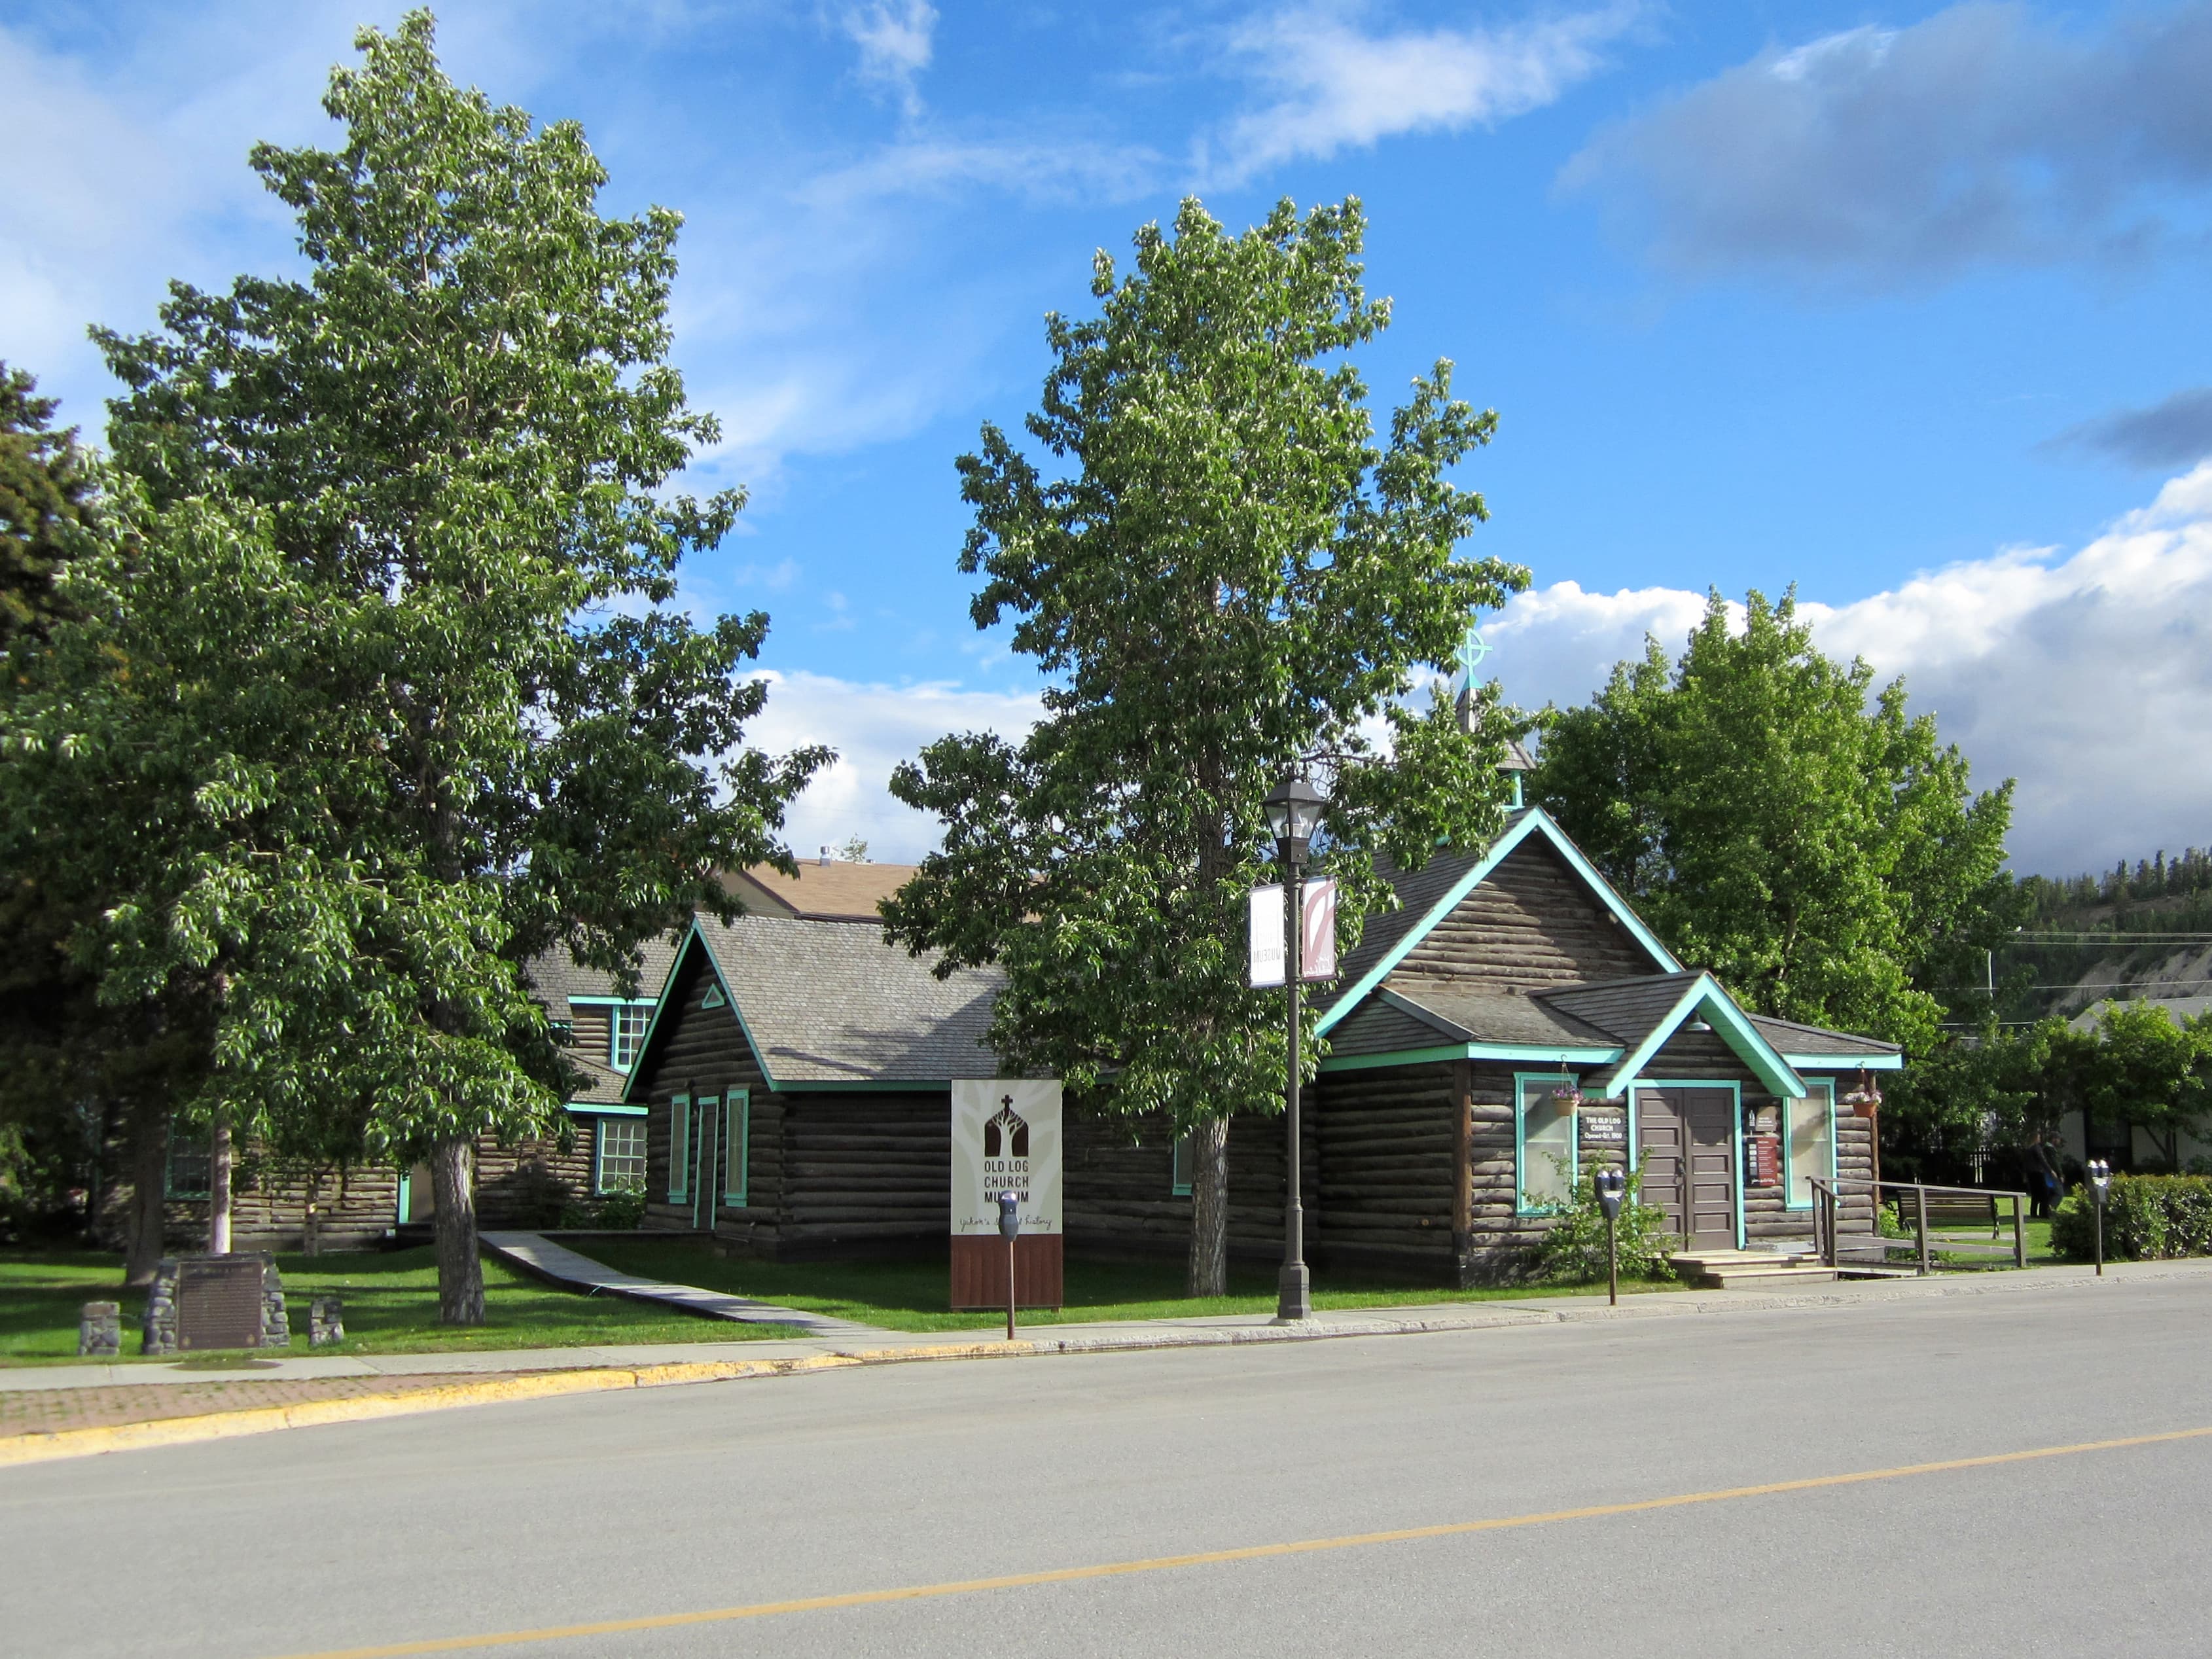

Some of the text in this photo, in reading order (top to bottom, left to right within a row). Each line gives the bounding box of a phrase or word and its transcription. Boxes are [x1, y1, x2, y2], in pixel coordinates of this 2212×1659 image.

[984, 1160, 1029, 1173] OLD LOG
[984, 1176, 1029, 1188] CHURCH
